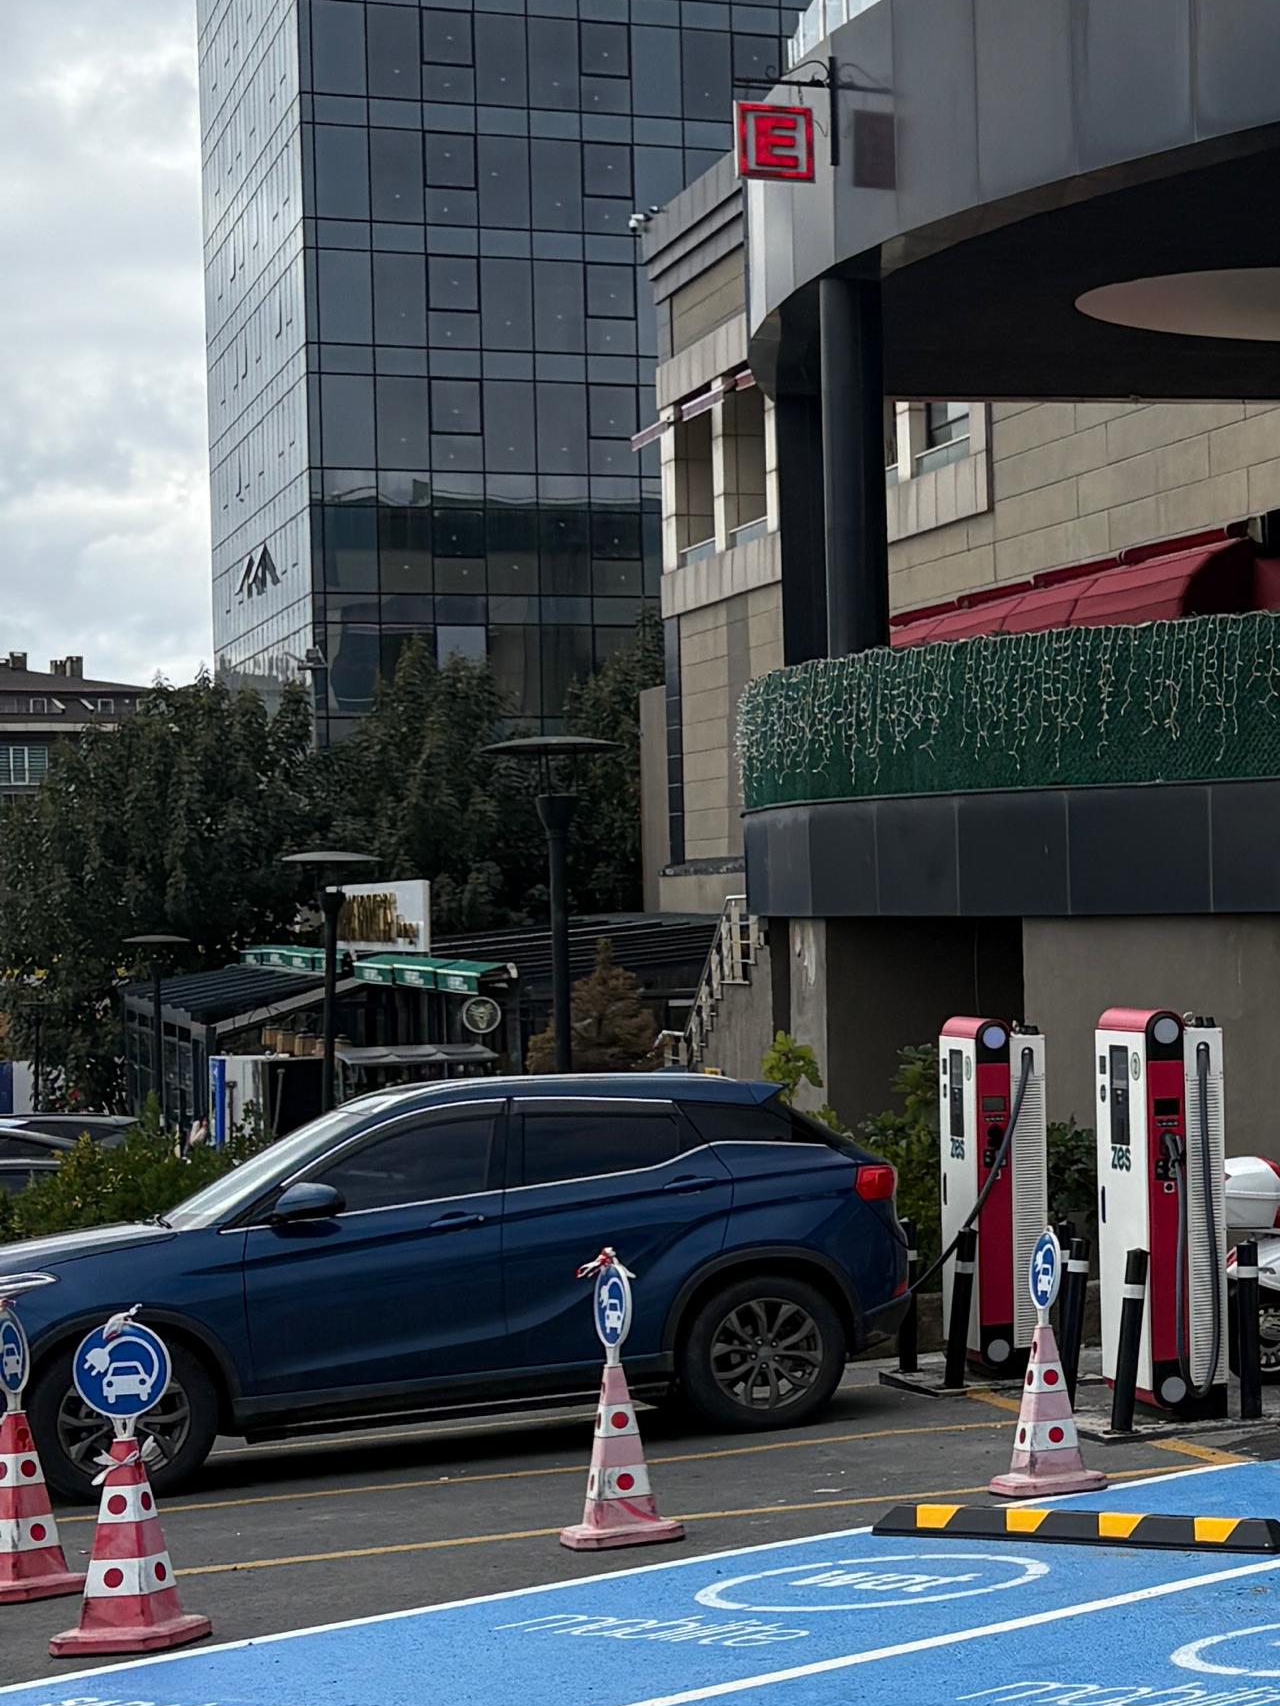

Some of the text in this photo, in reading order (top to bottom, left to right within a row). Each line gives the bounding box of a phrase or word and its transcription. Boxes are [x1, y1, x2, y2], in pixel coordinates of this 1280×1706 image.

[755, 116, 799, 169] E
[1111, 1145, 1132, 1173] zes
[790, 1569, 982, 1592] wat
[495, 1613, 810, 1647] mobilite
